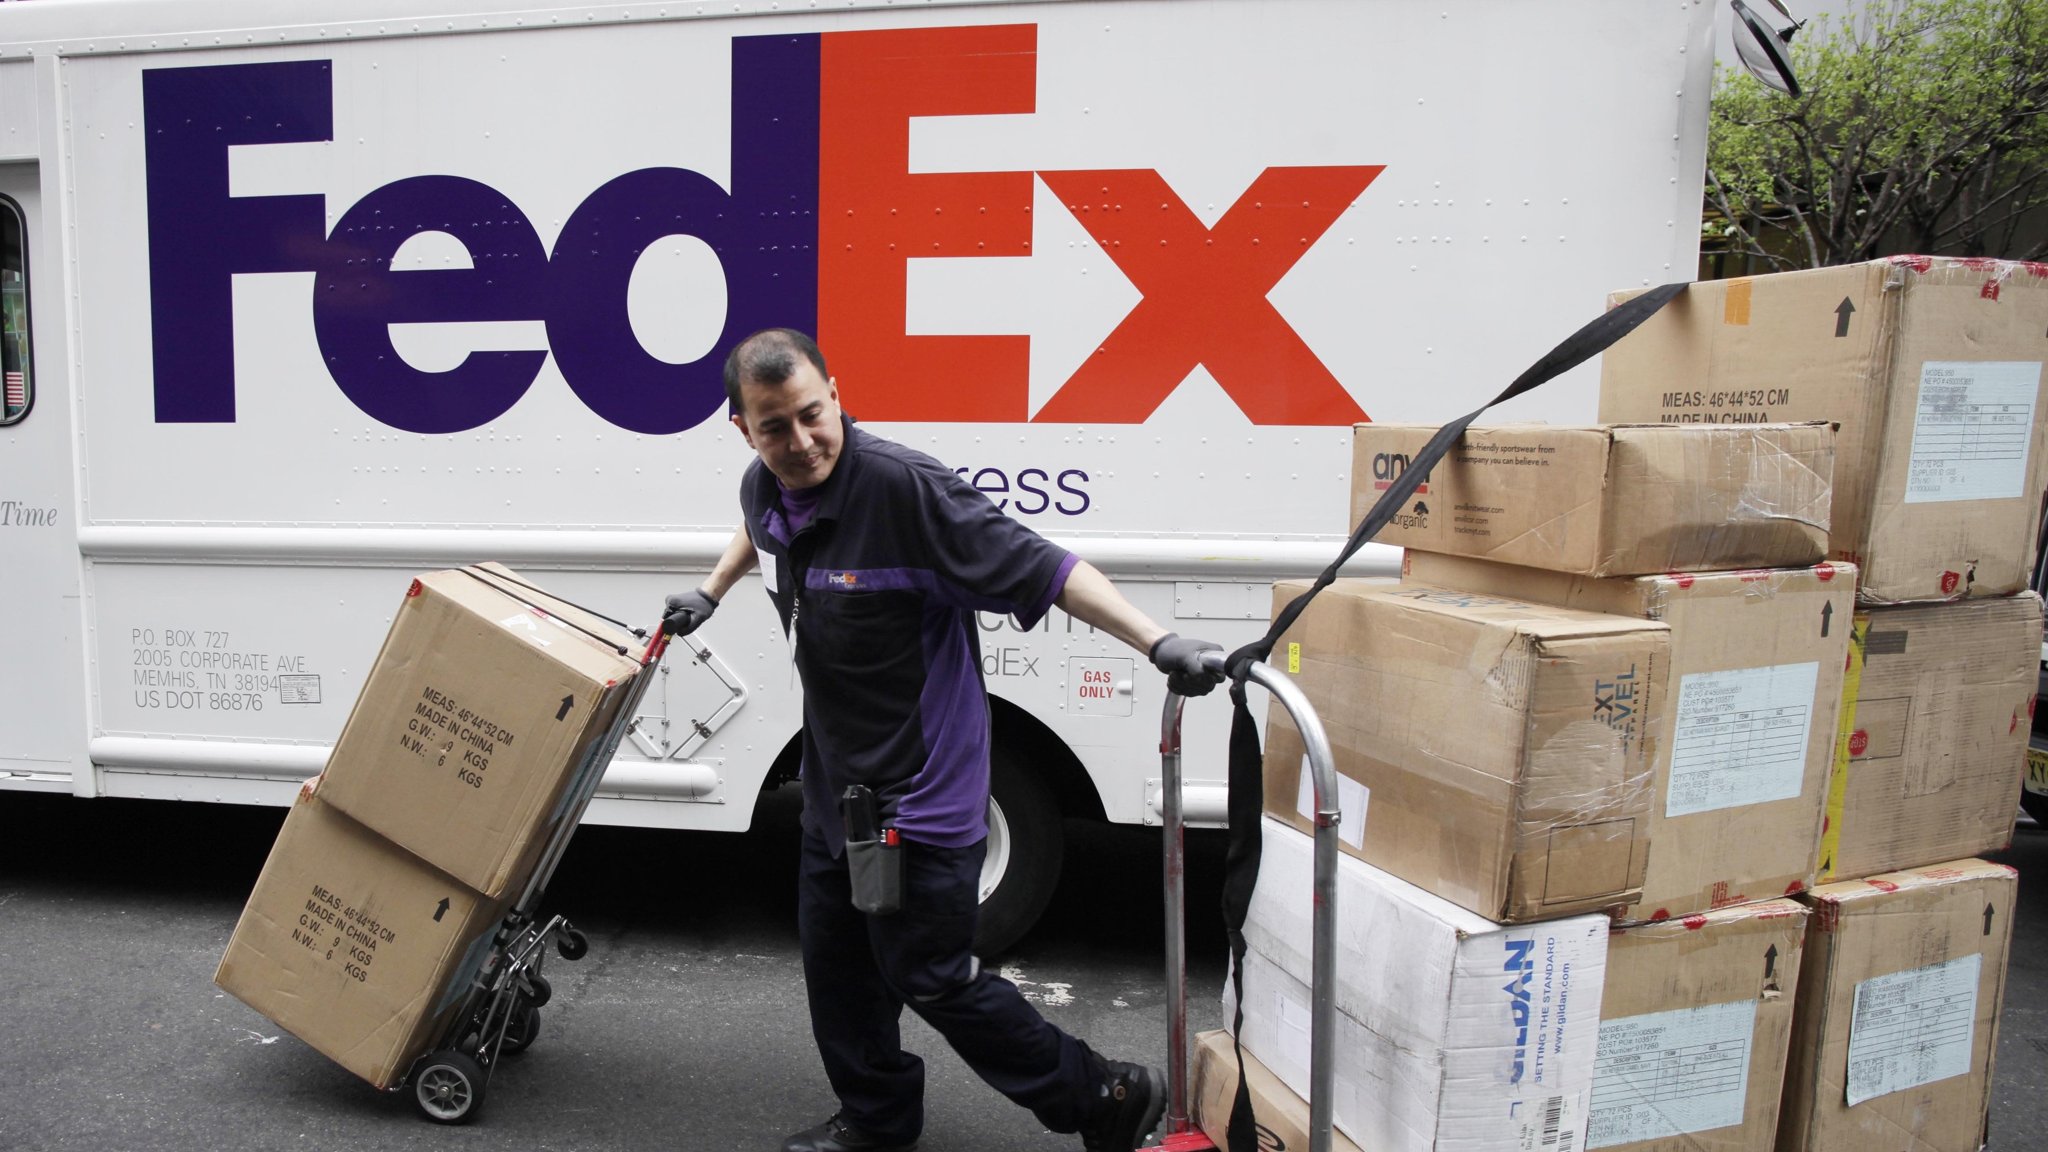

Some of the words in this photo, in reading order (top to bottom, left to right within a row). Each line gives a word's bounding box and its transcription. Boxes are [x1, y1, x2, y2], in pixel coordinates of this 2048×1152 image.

[142, 24, 1387, 434] FedEx
[1662, 392, 1706, 408] MEAS:
[1768, 389, 1788, 406] CM
[1704, 413, 1717, 424] IN
[1722, 412, 1768, 424] CHINA
[1500, 445, 1536, 455] sportswear
[1538, 444, 1556, 454] from
[1515, 456, 1540, 466] believe
[0, 501, 58, 526] Time
[133, 628, 158, 646] P.O.
[166, 630, 196, 647] BOX
[204, 632, 229, 648] 727
[134, 649, 172, 666] 2005
[180, 651, 269, 671] CORPORATE
[276, 655, 309, 673] AVE.
[206, 673, 226, 690] TN
[234, 673, 279, 692] 38194
[1083, 670, 1112, 684] GAS
[135, 690, 161, 709] US
[166, 691, 204, 709] DOT
[210, 692, 263, 711] 86876
[1079, 686, 1114, 699] ONLY
[415, 702, 448, 728] MADE
[448, 720, 460, 736] IN
[460, 728, 494, 756] CHINA
[422, 686, 458, 715] MEAS:
[496, 729, 515, 747] CM
[446, 741, 454, 752] 9
[464, 750, 489, 772] KGS
[438, 755, 446, 767] 6
[458, 767, 484, 789] KGS
[305, 899, 336, 924] MADE
[334, 917, 347, 932] IN
[346, 925, 377, 952] CHINA
[312, 885, 344, 912] MEAS:
[380, 928, 396, 944] CM
[332, 936, 340, 948] 9
[349, 945, 372, 966] KGS
[326, 950, 334, 960] 6
[344, 962, 368, 983] KGS
[1542, 936, 1556, 1004] STANDARD
[1540, 1004, 1550, 1030] THE
[1554, 962, 1570, 1055] www.gildan.com
[1534, 1030, 1546, 1083] SETTING
[1598, 1040, 1616, 1050] CUST
